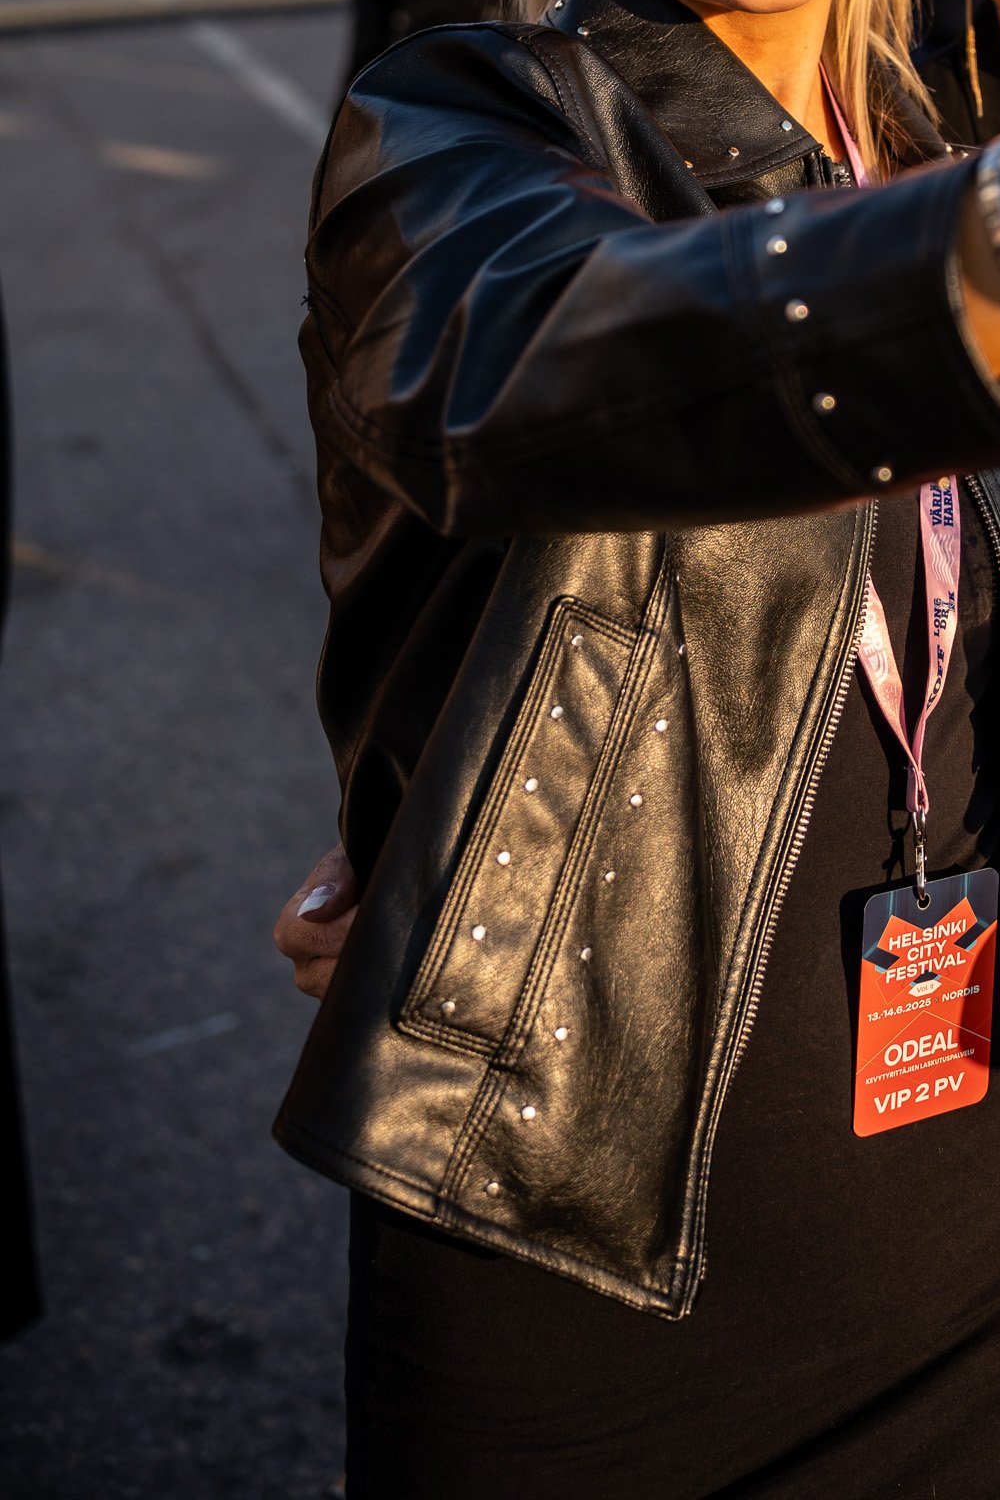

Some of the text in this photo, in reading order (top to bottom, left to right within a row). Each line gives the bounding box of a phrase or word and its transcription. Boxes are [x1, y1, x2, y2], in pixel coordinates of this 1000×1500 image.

[931, 484, 943, 527] VÄRIÄ
[934, 597, 942, 637] LONG
[927, 645, 945, 707] KOFF
[888, 918, 967, 950] HELSINKI
[906, 939, 948, 962] CITY
[885, 951, 967, 984] FESTIVAL
[867, 984, 980, 1022] 13.-14.6.2025 NORDIS
[865, 1048, 975, 1085] KEVYTYRITTÄJIEN LASKUTUSPALVELU
[884, 1028, 958, 1067] ODEAL
[873, 1072, 966, 1114] VIP 2 PV
